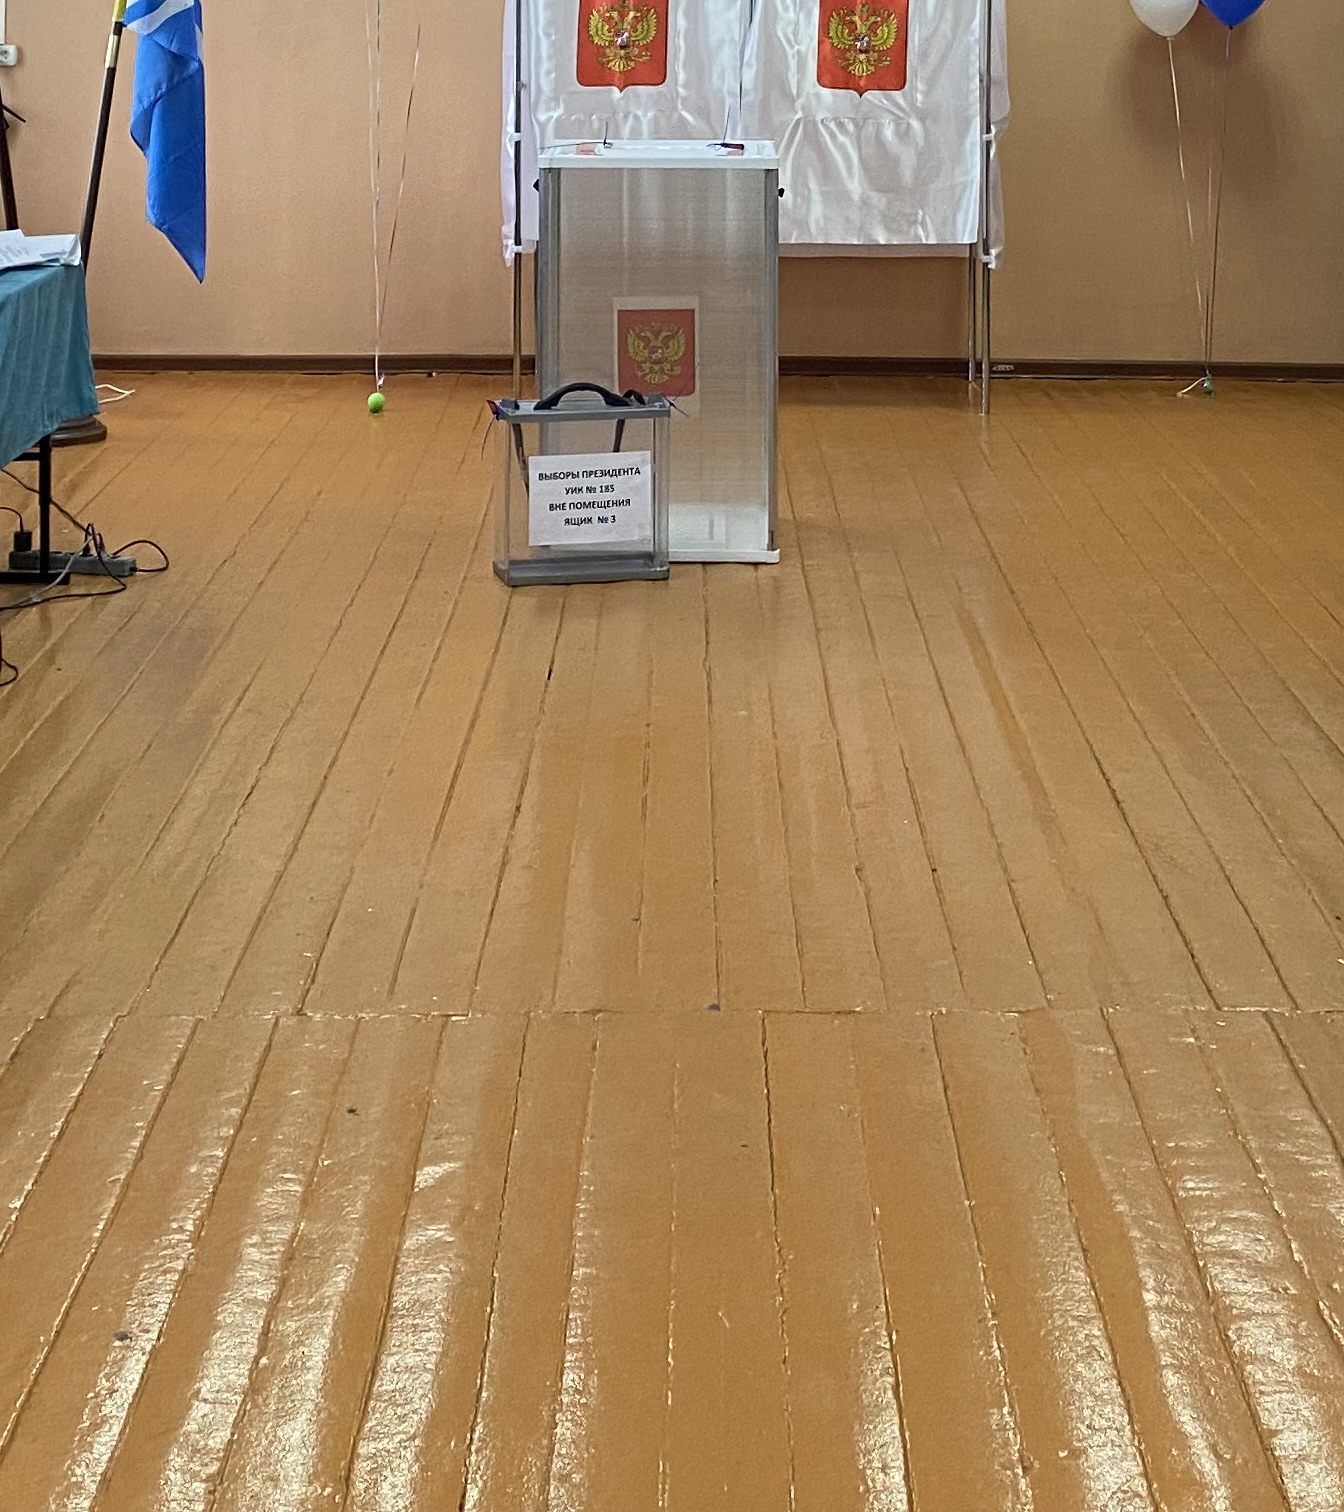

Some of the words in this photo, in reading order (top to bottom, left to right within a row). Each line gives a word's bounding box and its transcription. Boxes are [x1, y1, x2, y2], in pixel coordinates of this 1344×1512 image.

[538, 470, 580, 481] ВЫБОРЫ
[582, 467, 641, 479] ПРЕЗИДЕНТА
[564, 486, 584, 495] УИК
[586, 485, 597, 494] №
[549, 502, 567, 512] ВНЕ
[569, 498, 631, 510] ПОМЕЩЕНИЯ
[564, 516, 593, 527] ЯЩИК
[597, 515, 609, 524] №
[610, 514, 617, 524] 3
